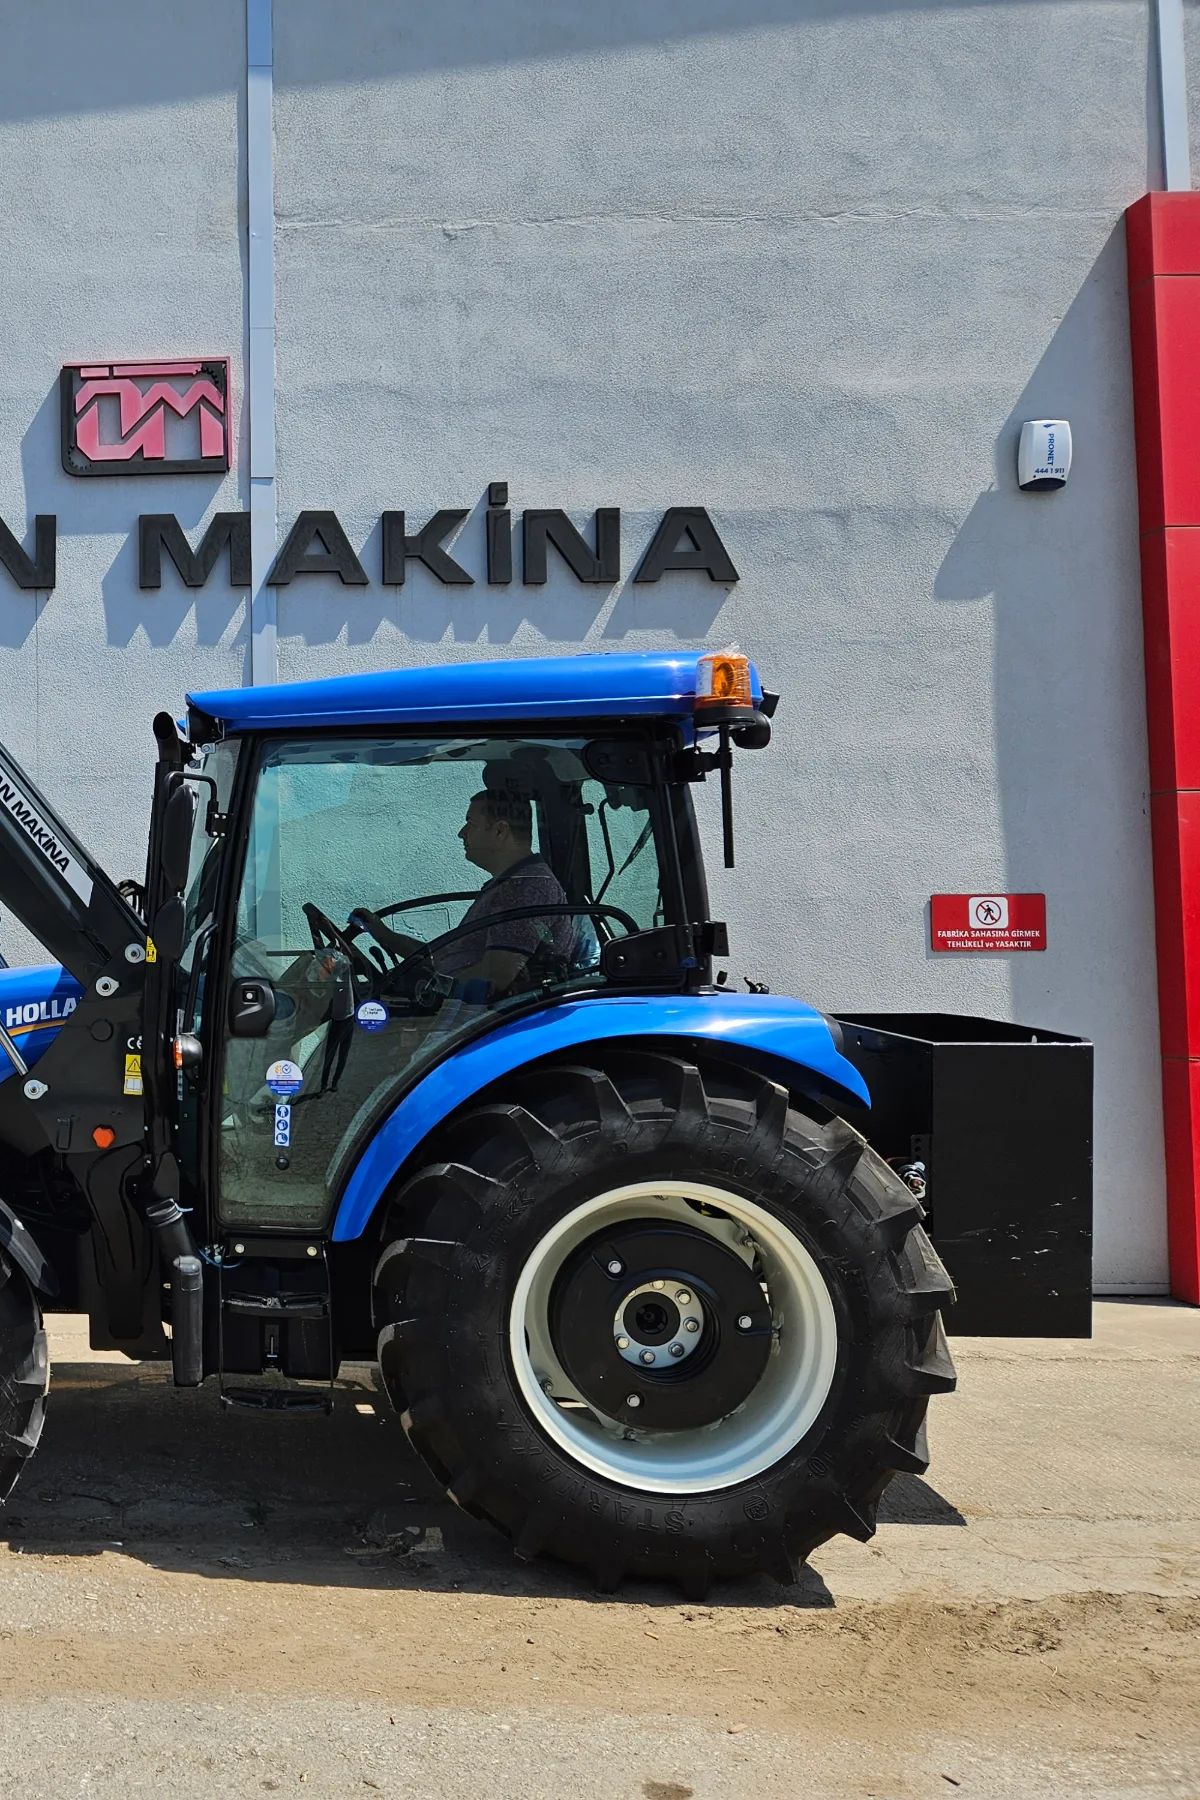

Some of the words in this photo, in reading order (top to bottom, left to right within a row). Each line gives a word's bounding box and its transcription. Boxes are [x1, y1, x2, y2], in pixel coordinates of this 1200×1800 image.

[1047, 433, 1055, 466] PRONET
[138, 481, 740, 588] MAKİNA
[11, 800, 71, 874] MAKİNA
[937, 929, 969, 937] FABRİKA
[1011, 929, 1040, 937] GİRMEK
[947, 939, 984, 948] TEHLİKELİ
[995, 940, 1032, 948] YASAKTIR
[6, 997, 83, 1027] HOLLA
